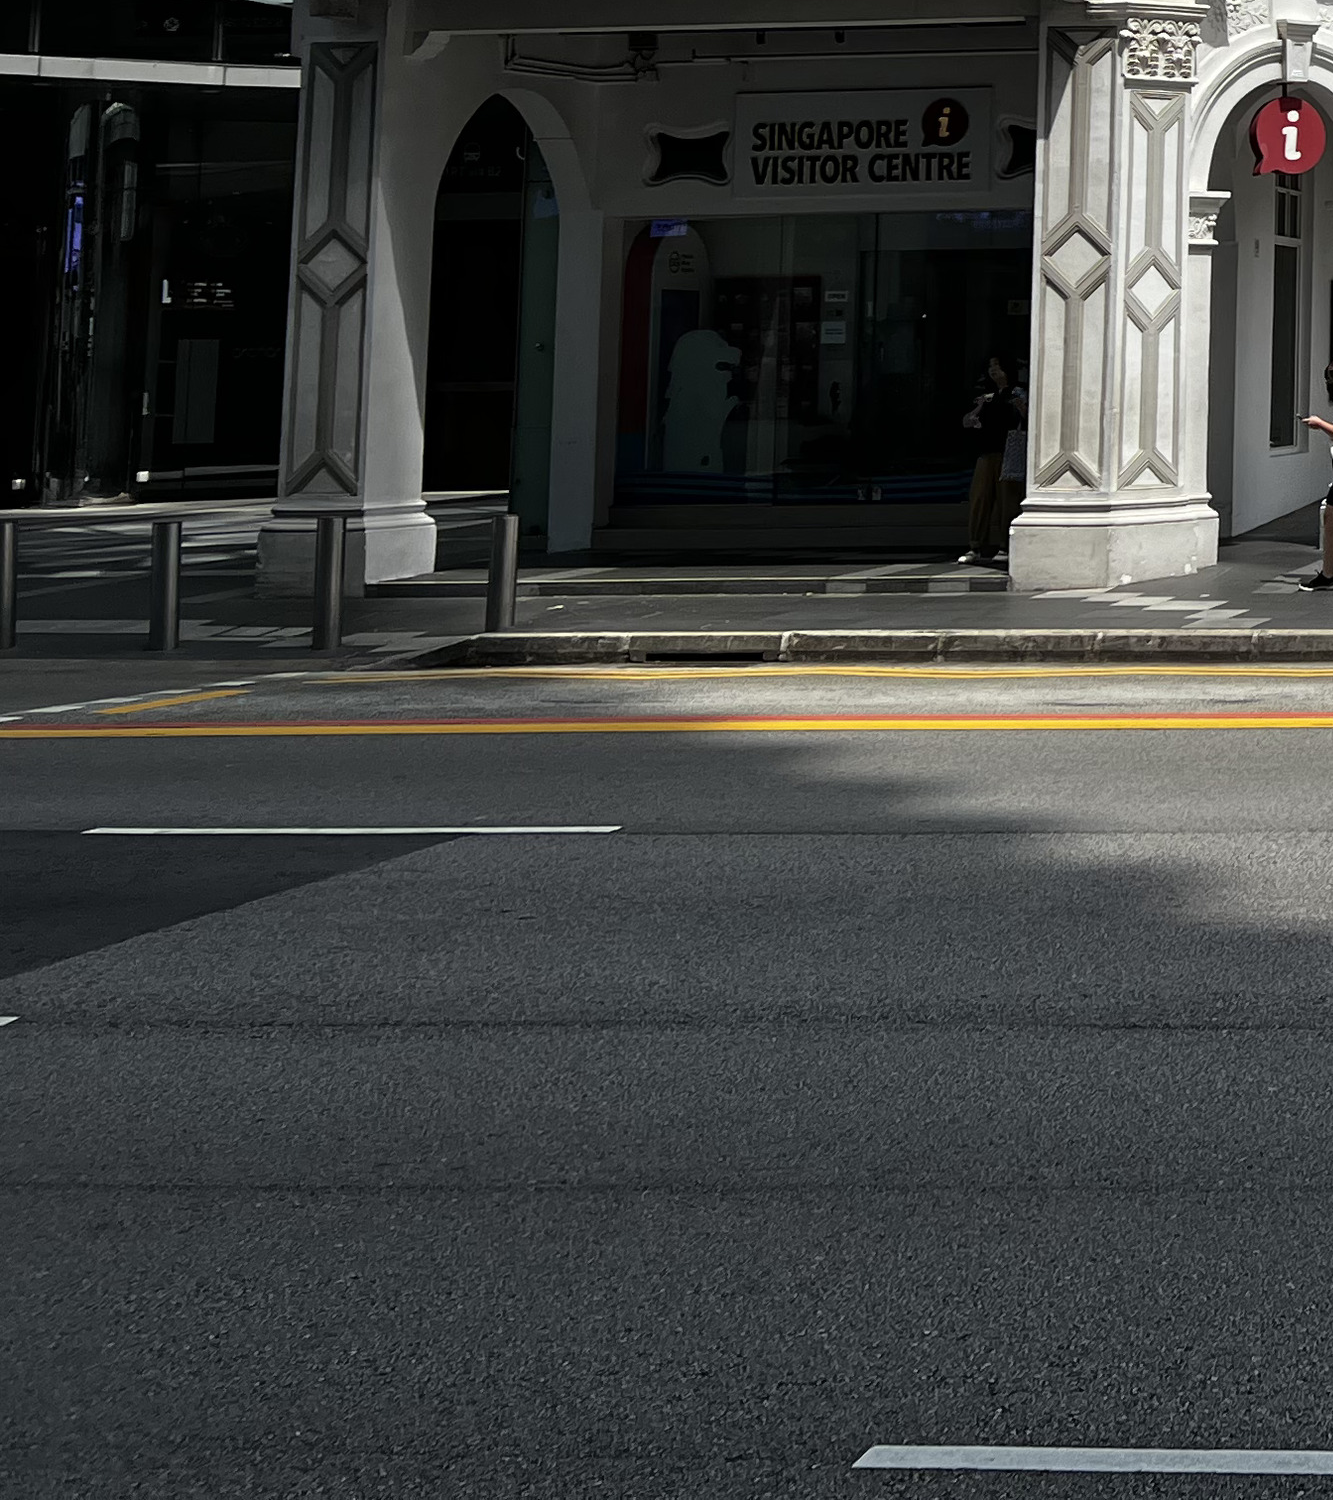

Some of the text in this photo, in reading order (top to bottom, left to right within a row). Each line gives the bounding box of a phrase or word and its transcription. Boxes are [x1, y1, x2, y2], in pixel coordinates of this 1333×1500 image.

[751, 119, 909, 152] SINGAPORE
[751, 151, 972, 186] VISITOR CENTRE
